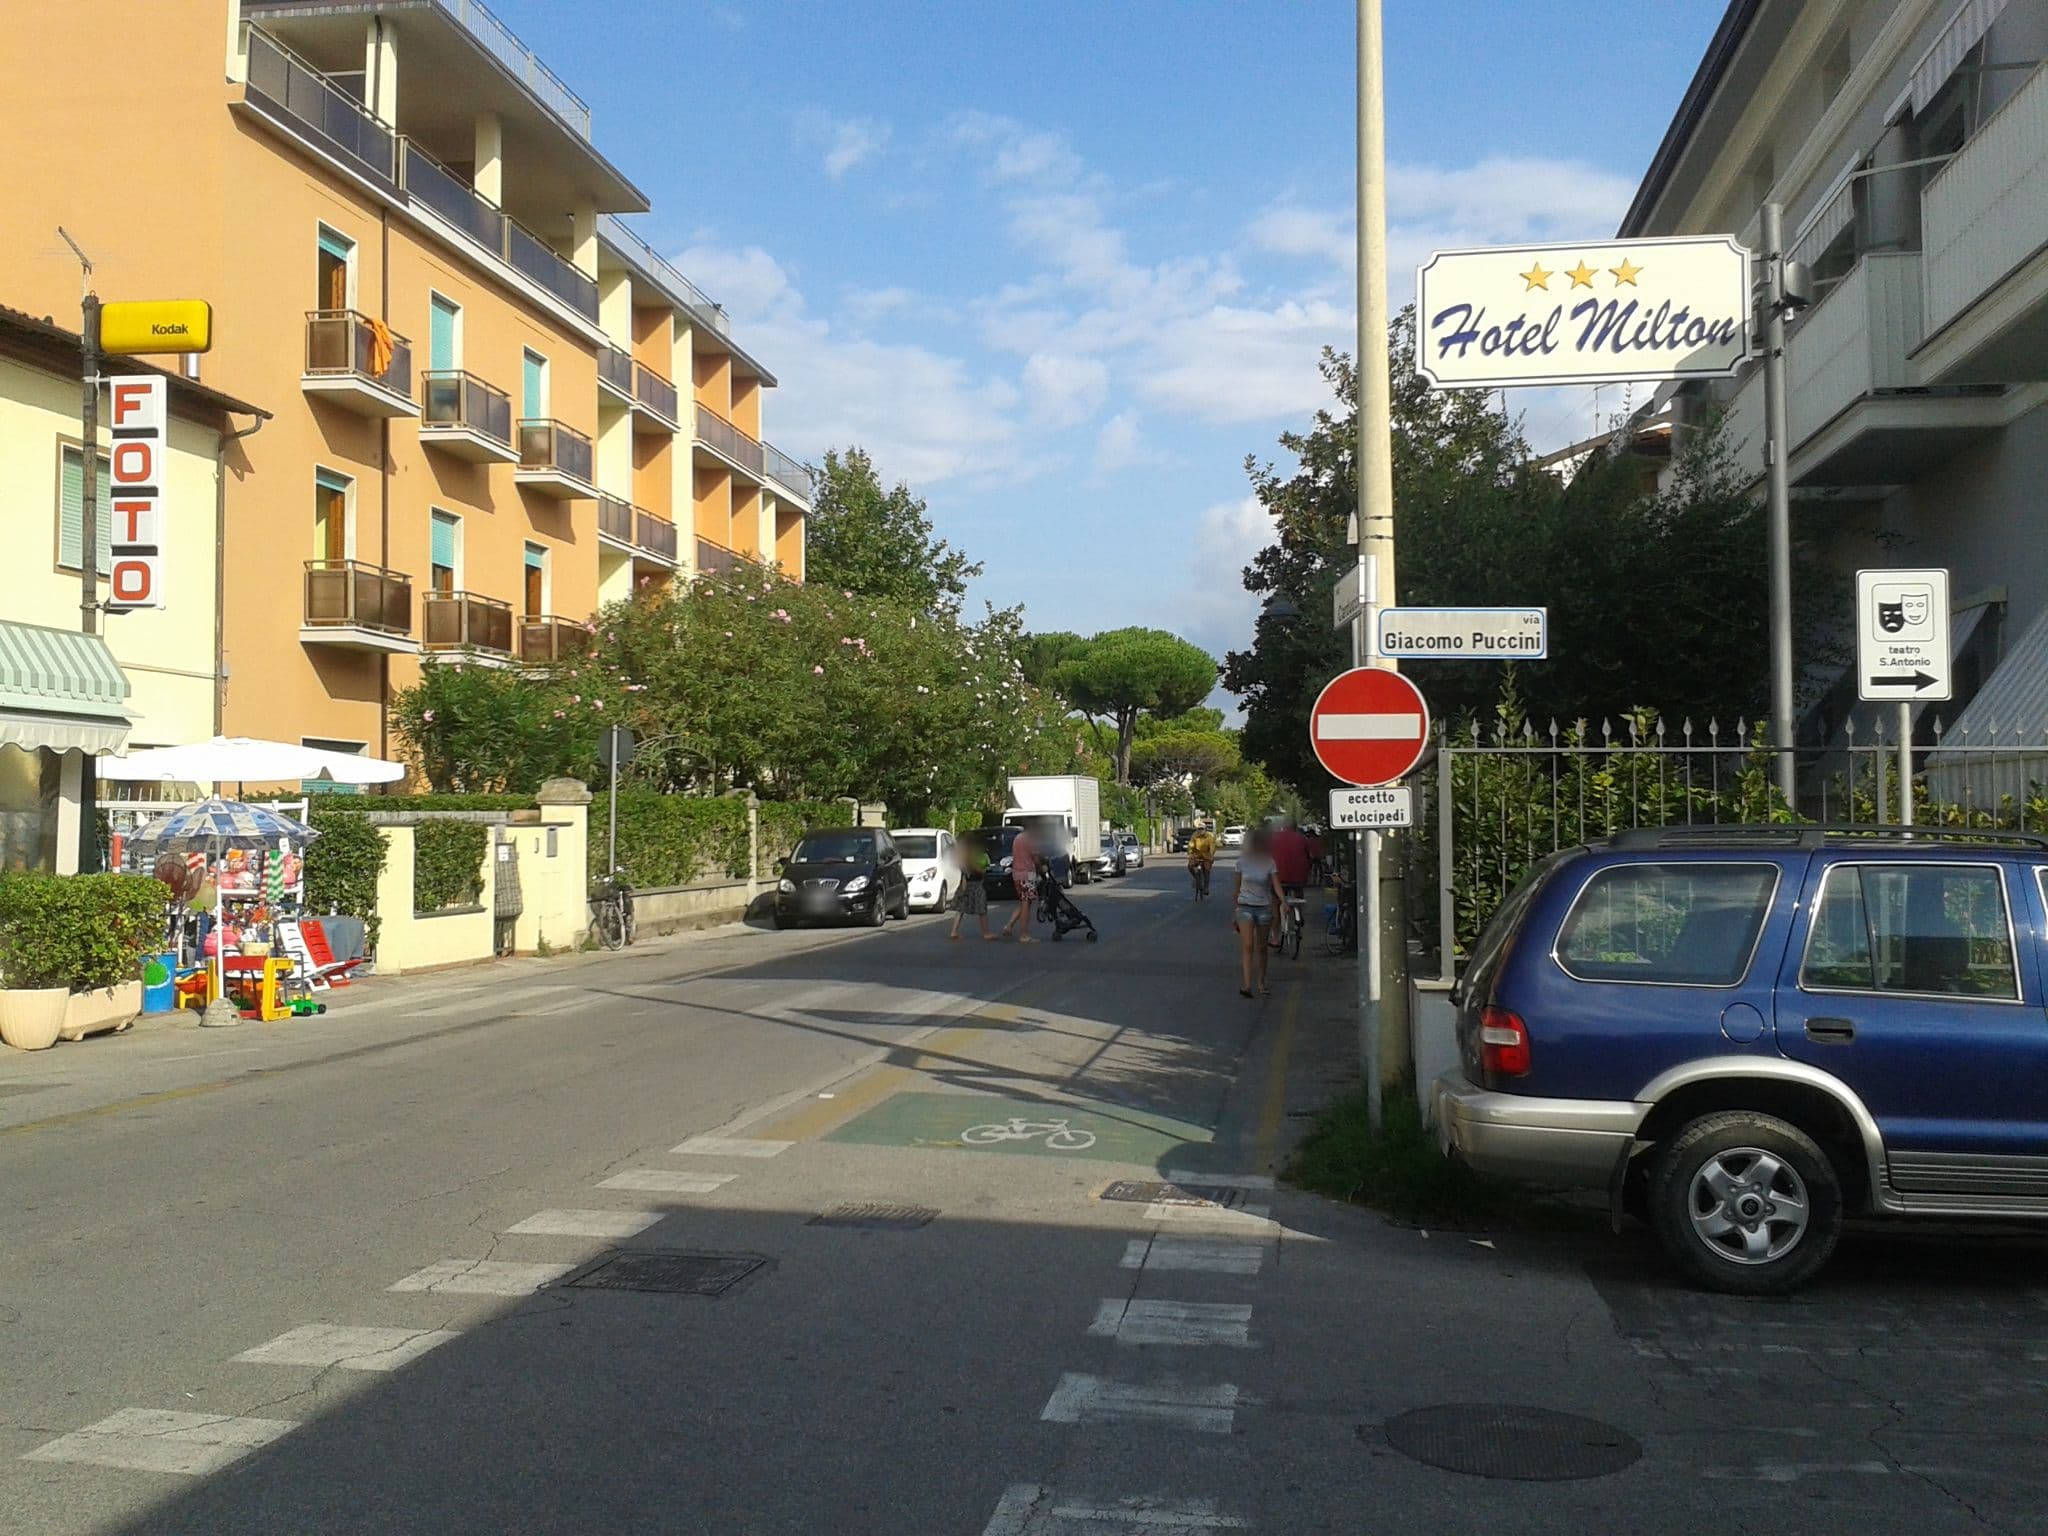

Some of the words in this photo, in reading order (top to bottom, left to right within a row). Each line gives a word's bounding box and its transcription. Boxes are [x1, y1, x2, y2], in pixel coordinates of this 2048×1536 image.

[151, 323, 189, 336] Kodak
[1431, 303, 1563, 360] Hotel
[1570, 298, 1736, 354] Milton
[113, 384, 152, 601] FOTO
[1522, 614, 1541, 625] via
[1384, 631, 1464, 650] Giacomo
[1472, 631, 1541, 650] Puccini
[1888, 645, 1921, 655] teatro
[1879, 657, 1931, 667] S.Antonio
[1348, 791, 1396, 804] eccetto
[1340, 808, 1405, 824] velocipedi
